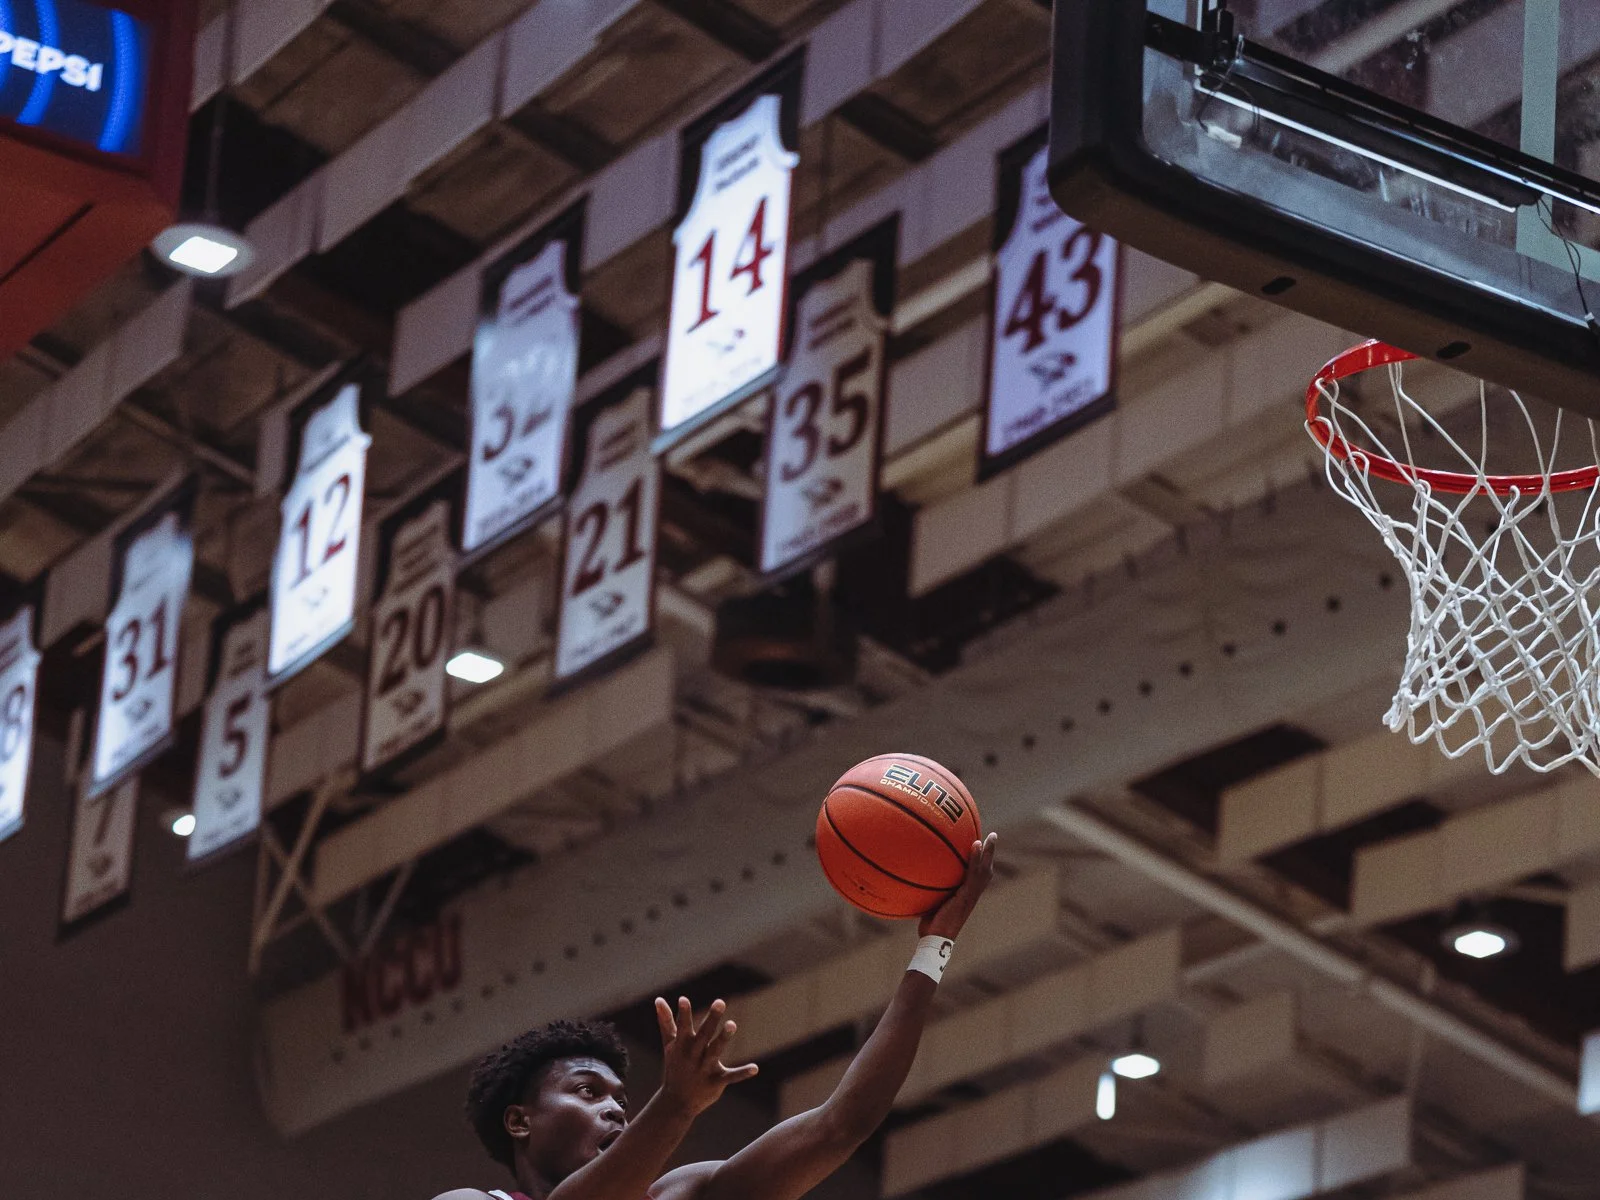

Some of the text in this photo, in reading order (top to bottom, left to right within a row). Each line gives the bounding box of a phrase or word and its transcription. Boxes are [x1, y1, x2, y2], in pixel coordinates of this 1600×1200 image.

[686, 195, 773, 334] 14
[1003, 226, 1103, 355] 43
[780, 346, 876, 484] 35
[290, 473, 351, 591] 12
[572, 475, 645, 598] 21
[112, 594, 170, 702] 31
[378, 584, 446, 695] 20
[218, 692, 254, 779] 5
[884, 763, 964, 825] ELITE
[341, 912, 462, 1036] NCCU
